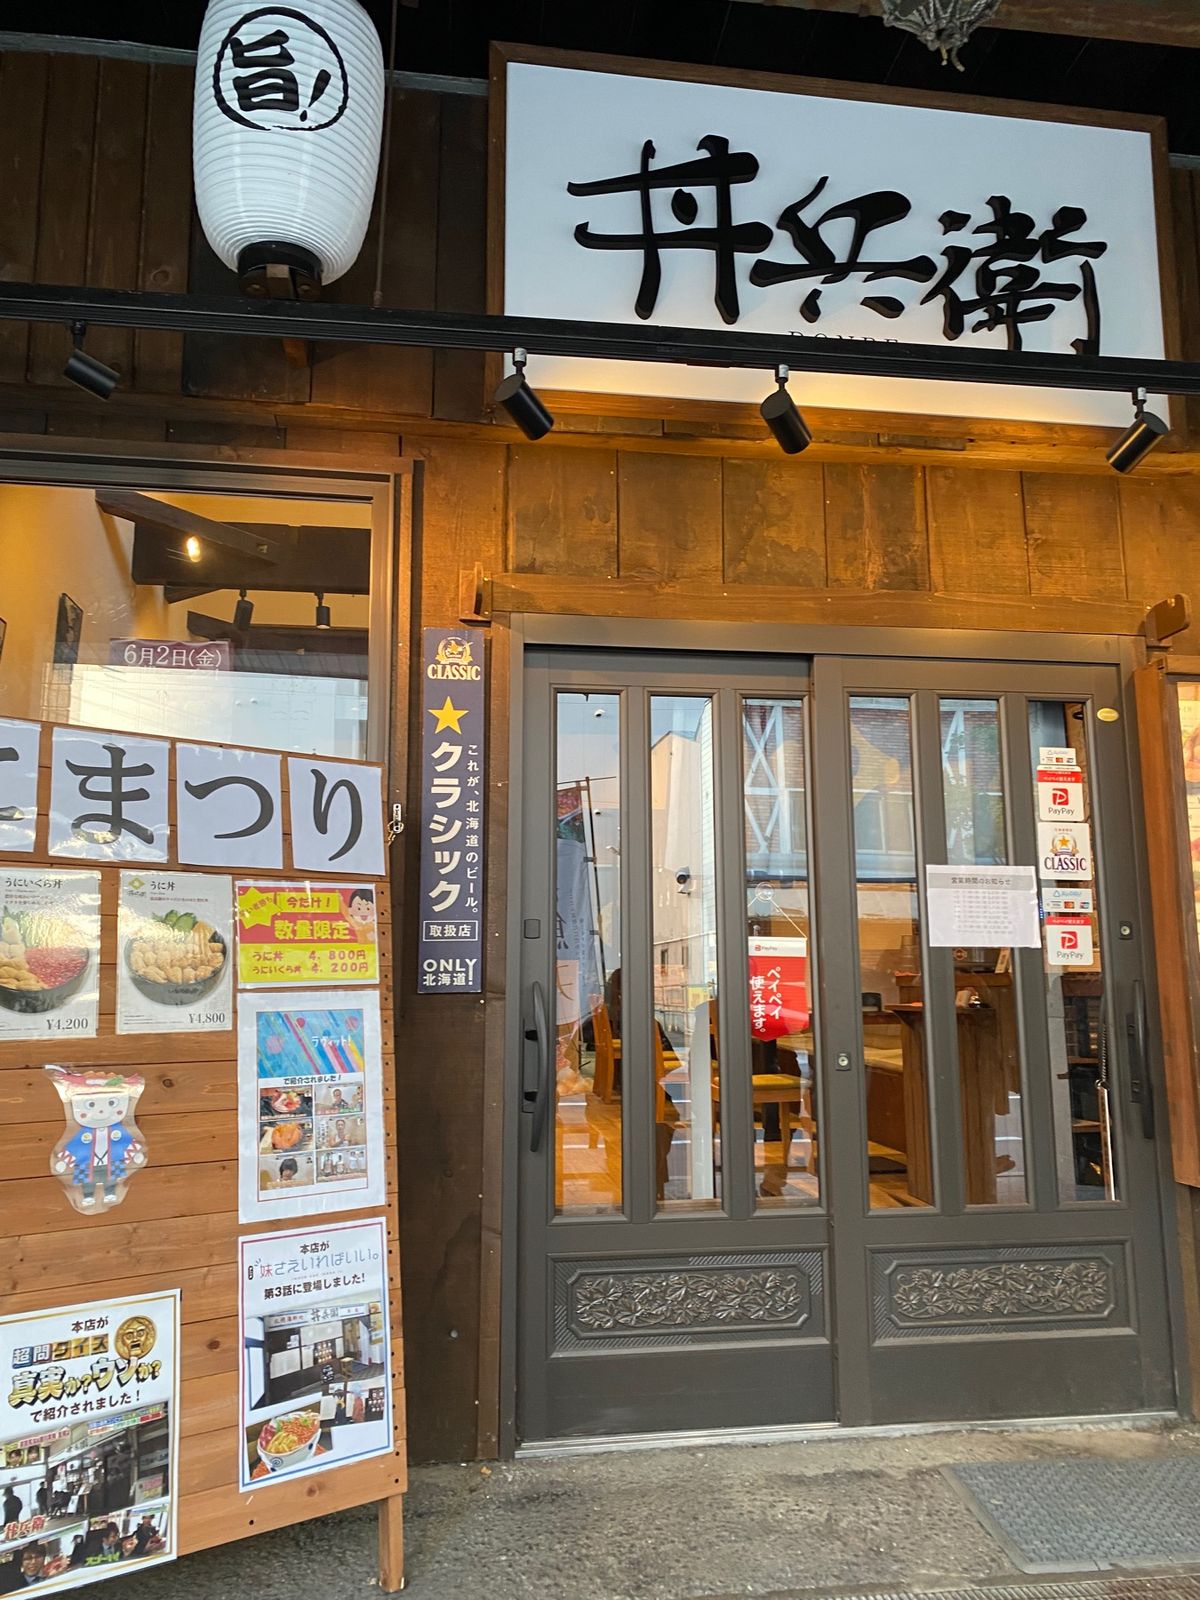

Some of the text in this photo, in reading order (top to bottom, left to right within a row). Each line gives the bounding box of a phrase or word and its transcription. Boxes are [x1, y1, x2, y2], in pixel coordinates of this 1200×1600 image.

[123, 643, 222, 668] 6月2日(金)
[427, 663, 481, 681] CLASSIC
[0, 743, 363, 862] まつり
[1047, 807, 1075, 815] PayPay
[430, 741, 463, 913] クラシック
[465, 744, 480, 914] これが、北海道のビール。
[1044, 857, 1087, 871] CLASSIC
[150, 881, 175, 891] うに丼
[274, 920, 352, 939] 数量限定
[429, 924, 472, 937] 取扱店
[1056, 951, 1083, 959] PayPay
[767, 966, 782, 1020] ペイペイ
[749, 975, 766, 1033] 使えます。
[300, 1240, 330, 1254] 本店が
[71, 1316, 109, 1333] 本店が
